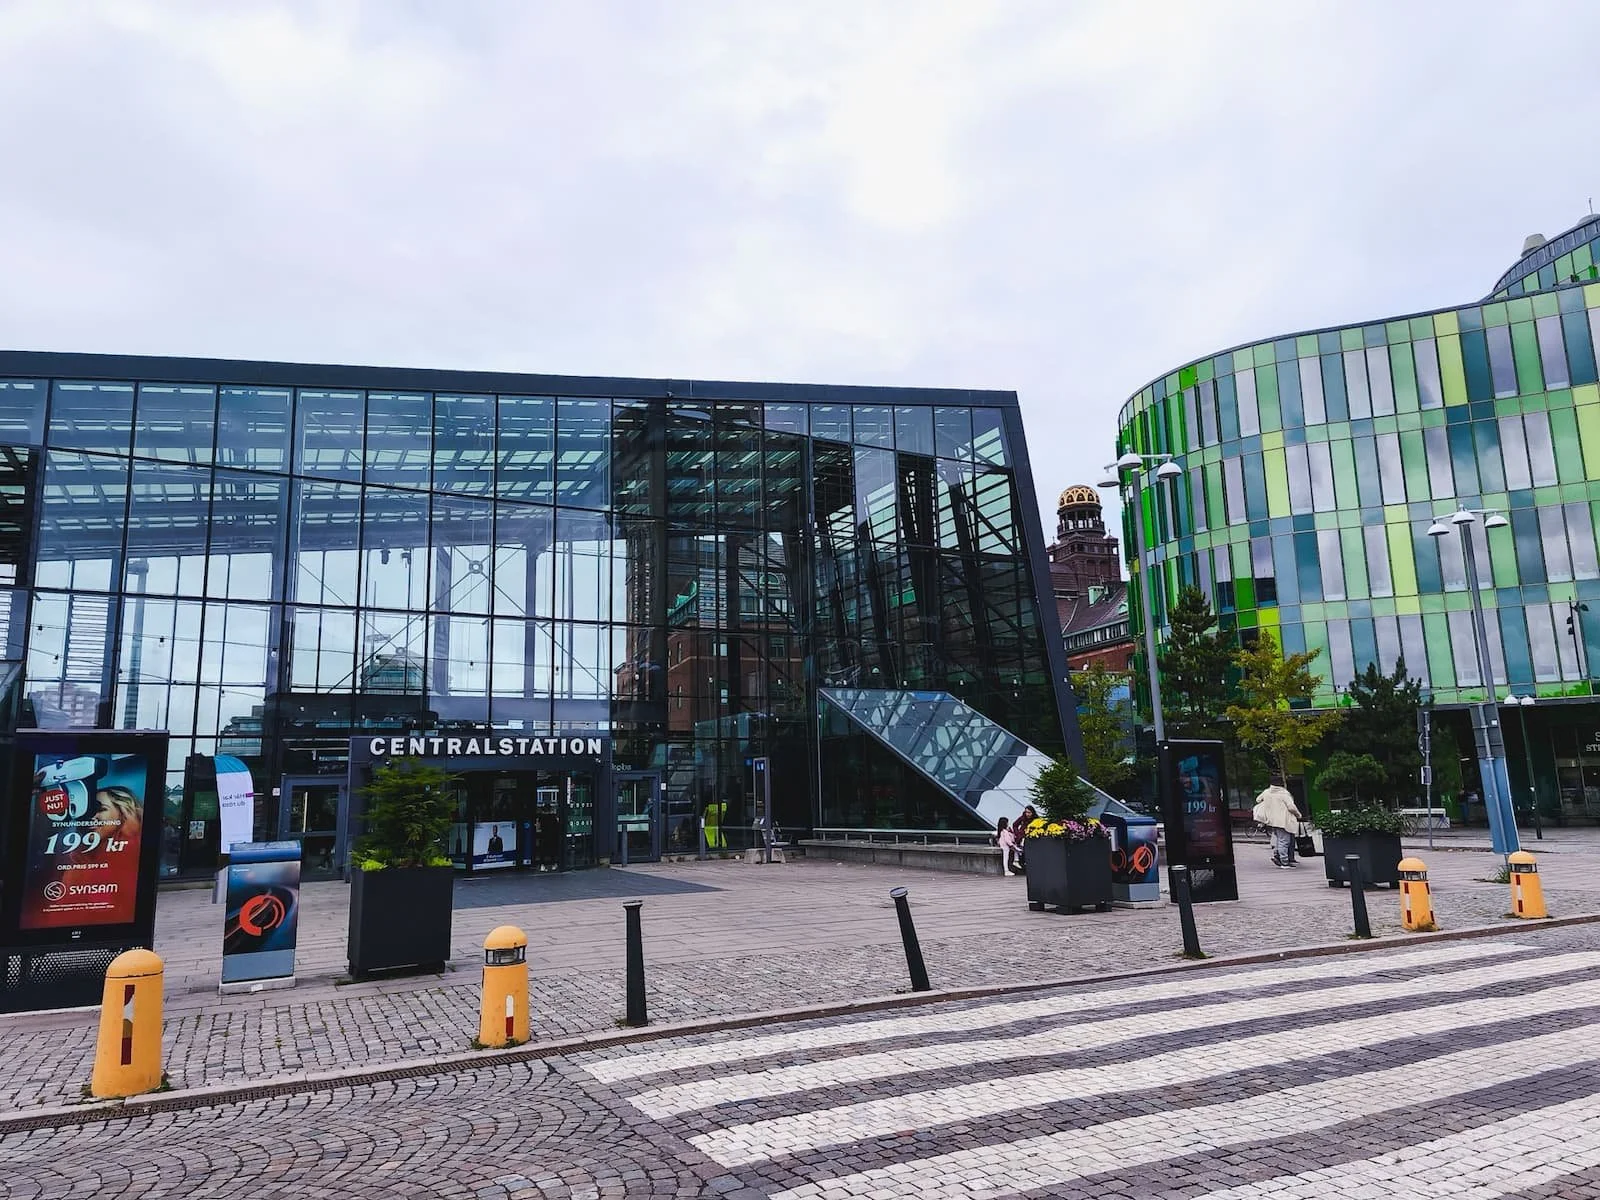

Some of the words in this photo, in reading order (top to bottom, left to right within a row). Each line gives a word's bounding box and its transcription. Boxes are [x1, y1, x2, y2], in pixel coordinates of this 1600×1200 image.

[369, 737, 601, 756] CENTRALSTATION
[45, 794, 65, 803] JUST
[1187, 801, 1207, 813] 199
[1208, 803, 1217, 813] kr
[44, 832, 101, 854] 199
[106, 837, 128, 852] kr
[69, 883, 118, 895] SYNSAM
